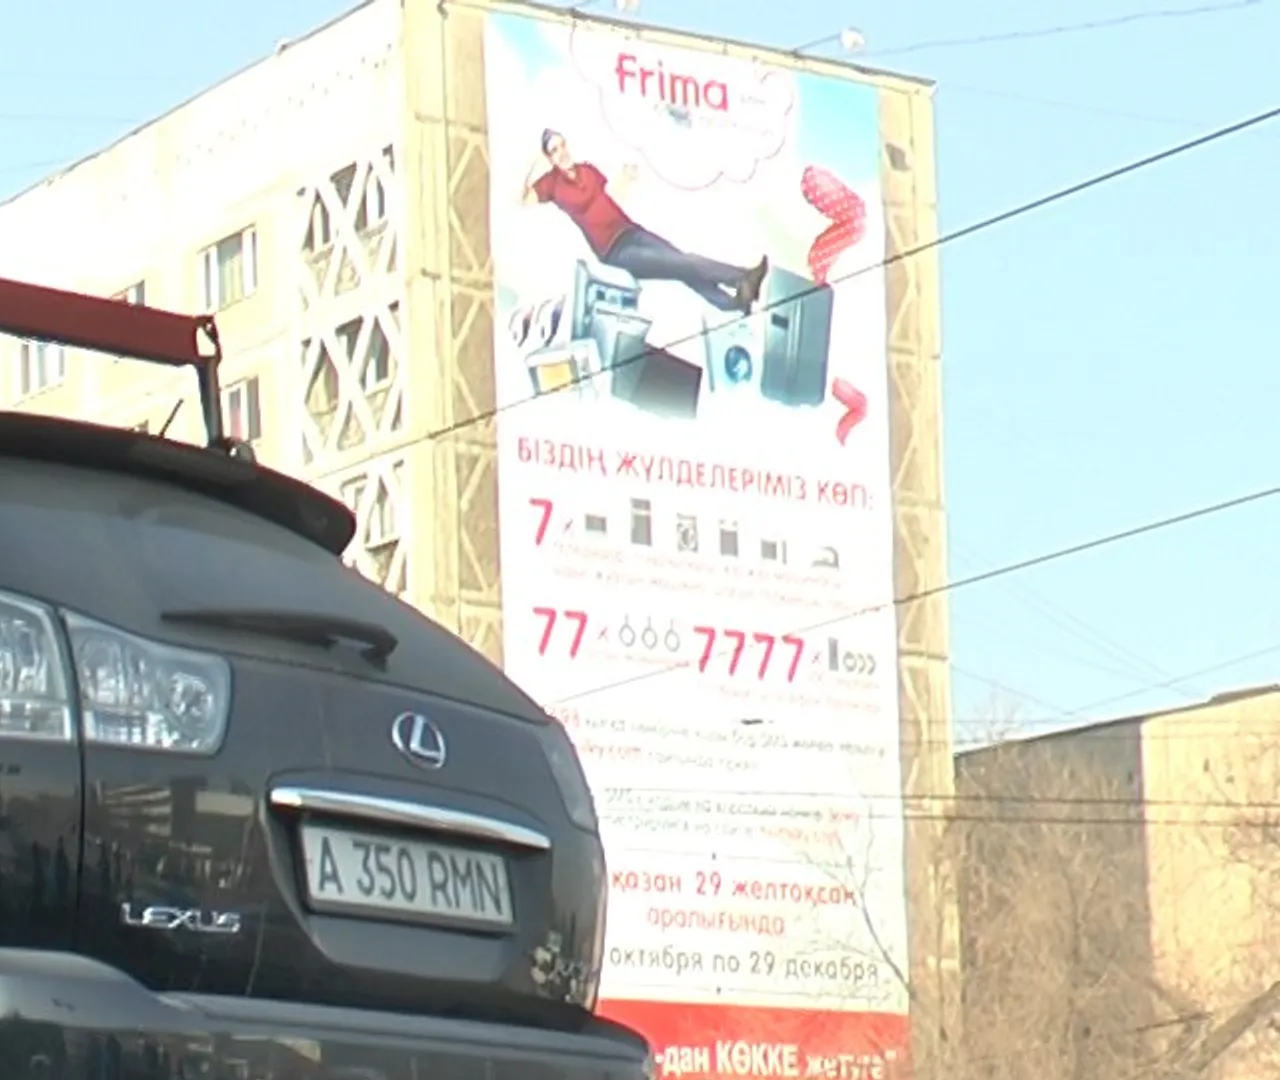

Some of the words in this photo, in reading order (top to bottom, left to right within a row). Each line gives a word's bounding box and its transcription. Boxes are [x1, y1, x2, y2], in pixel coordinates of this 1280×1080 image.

[528, 497, 554, 546] 7
[532, 606, 588, 660] 77
[692, 625, 805, 684] 7777
[317, 835, 345, 894] A
[351, 837, 418, 904] 350
[426, 850, 504, 916] RMN
[695, 870, 722, 896] 29
[121, 901, 241, 933] LEXUS
[609, 943, 704, 977] октября
[712, 953, 741, 974] по
[748, 950, 776, 977] 29
[784, 956, 879, 987] декабря
[715, 1039, 799, 1077] КӨККЕ
